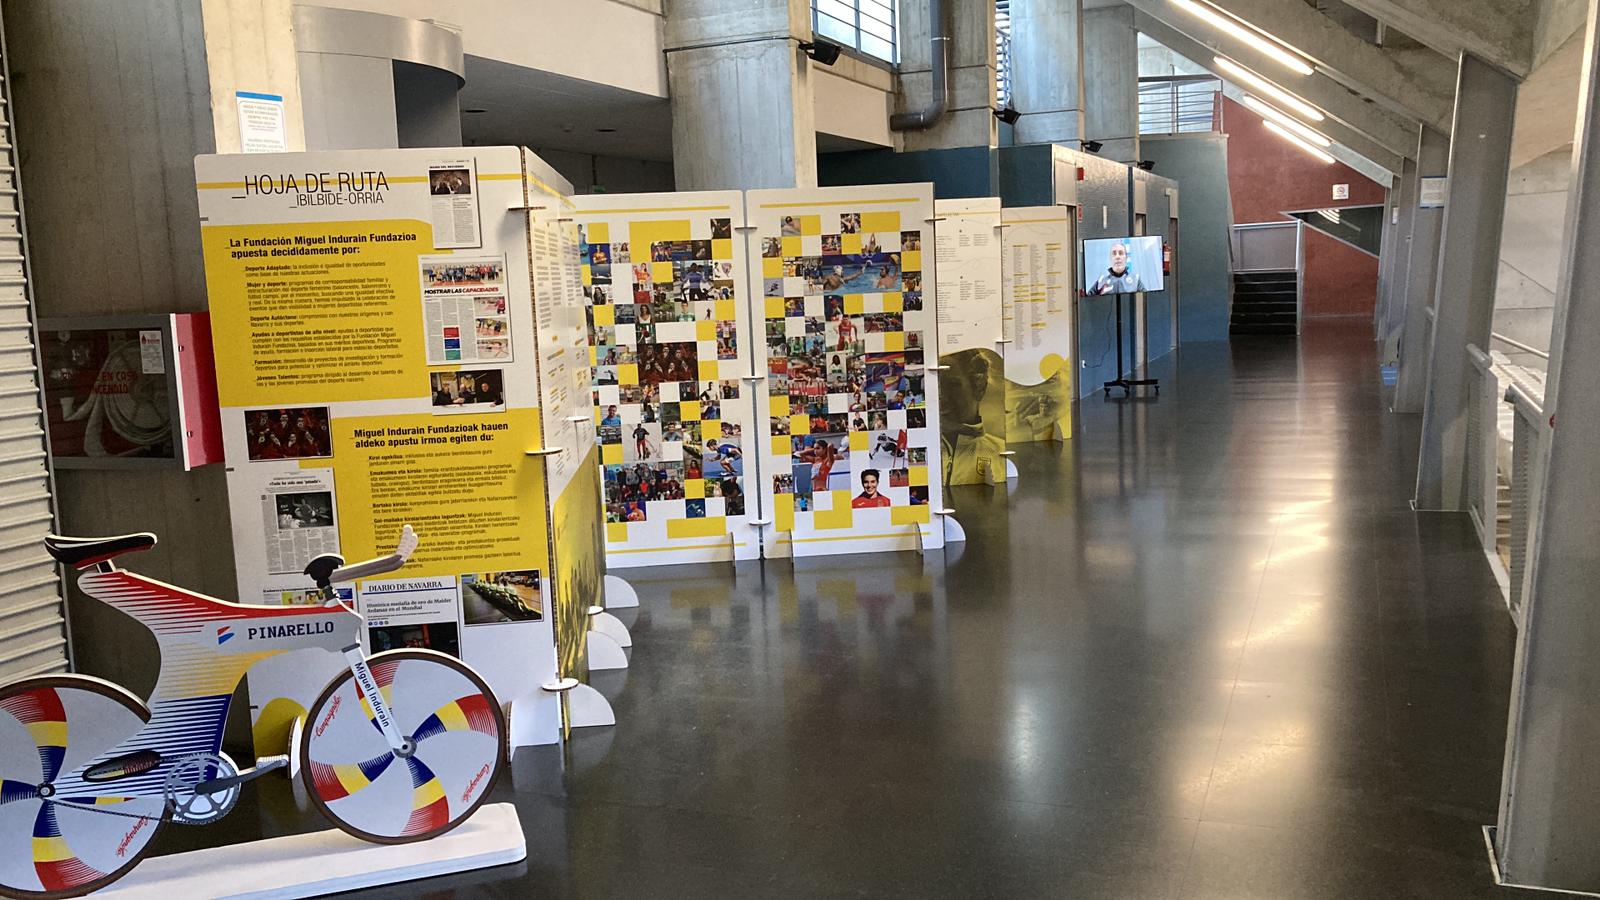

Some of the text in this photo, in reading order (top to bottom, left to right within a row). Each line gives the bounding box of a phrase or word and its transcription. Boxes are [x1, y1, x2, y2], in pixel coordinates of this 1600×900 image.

[306, 172, 332, 194] DE
[338, 171, 389, 192] RUTA
[230, 232, 416, 248] La Fundación Miguel Indurain Fundazioa
[231, 248, 268, 260] apuesta
[342, 246, 360, 257] por:
[354, 423, 508, 439] Miguel Indurain Fundazioak hauen
[356, 433, 494, 448] aldeko apustu irmoa egiten du:
[248, 622, 334, 640] PINARELLO
[354, 662, 389, 728] Miguel Indurain
